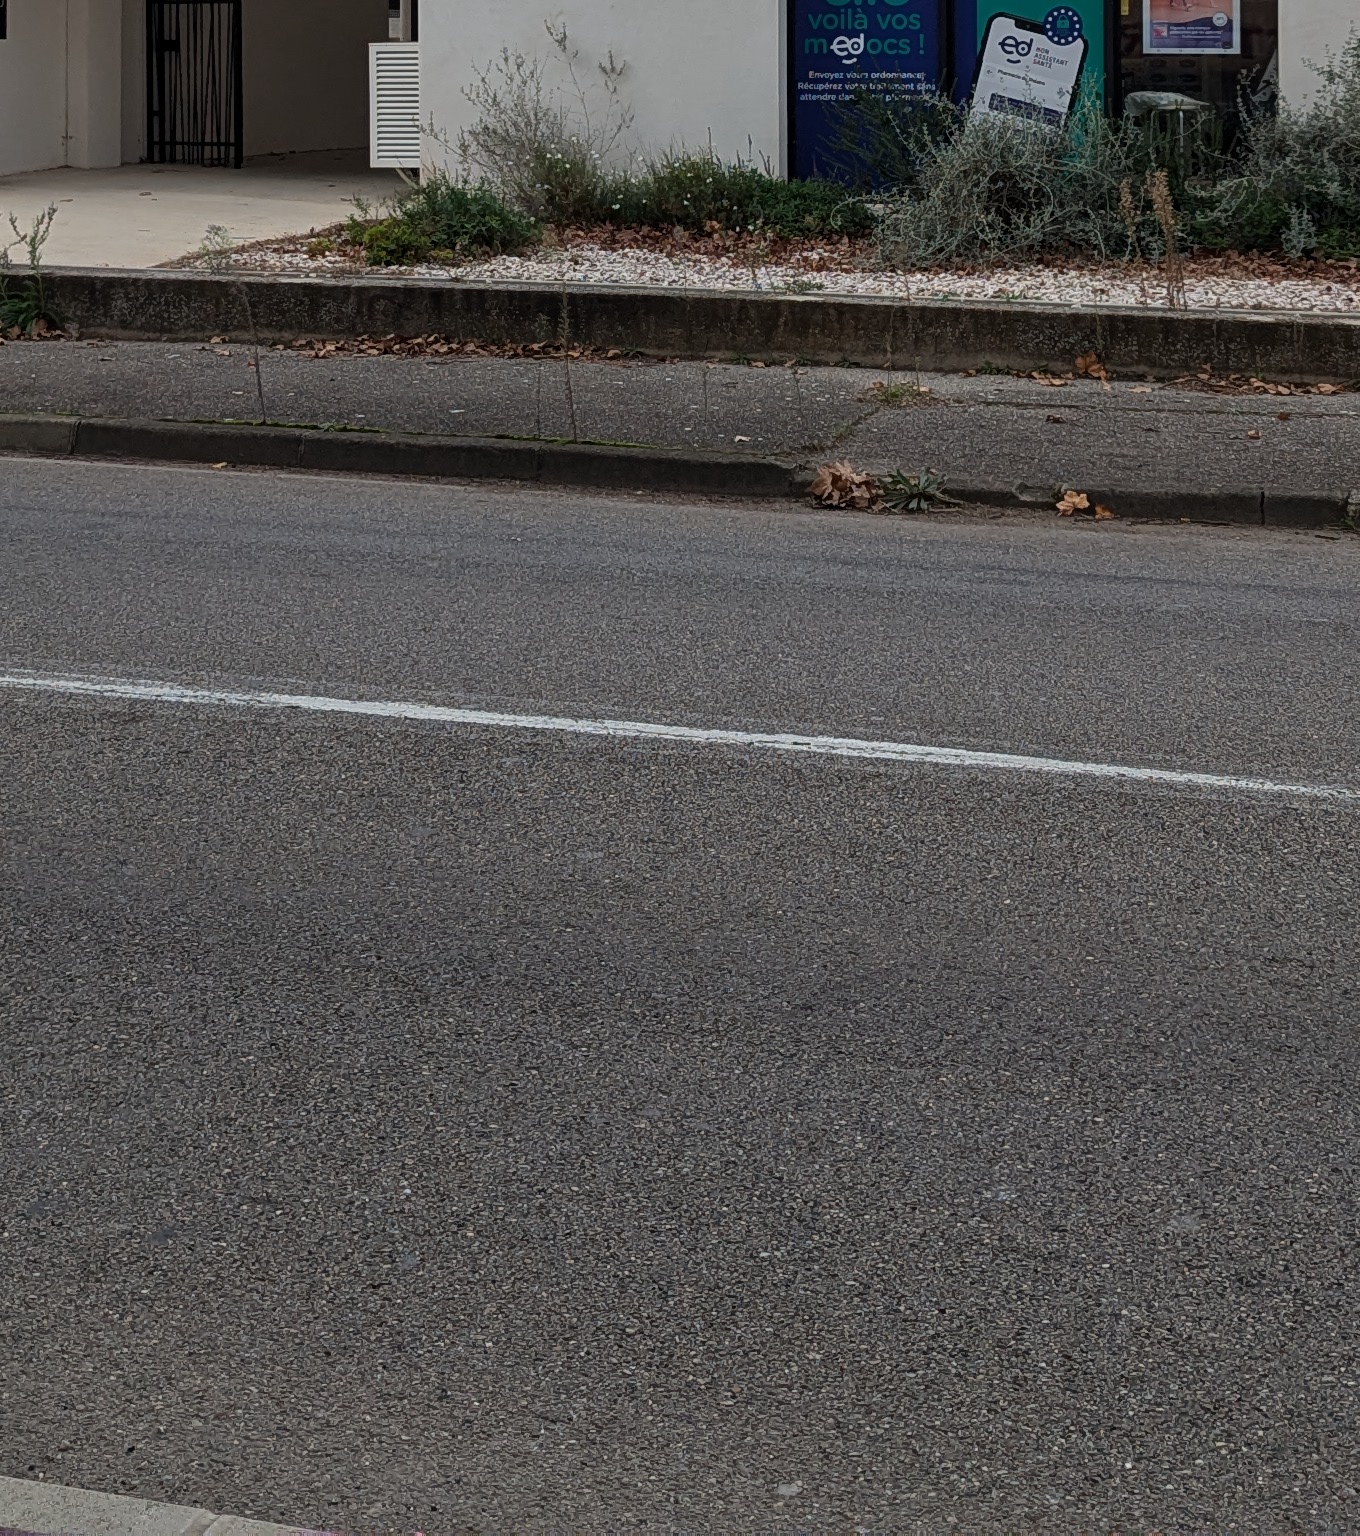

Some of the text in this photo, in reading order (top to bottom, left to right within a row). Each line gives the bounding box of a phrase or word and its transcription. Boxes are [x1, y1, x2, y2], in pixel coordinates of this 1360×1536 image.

[808, 7, 921, 30] voilà vos
[797, 81, 843, 91] Récupérez
